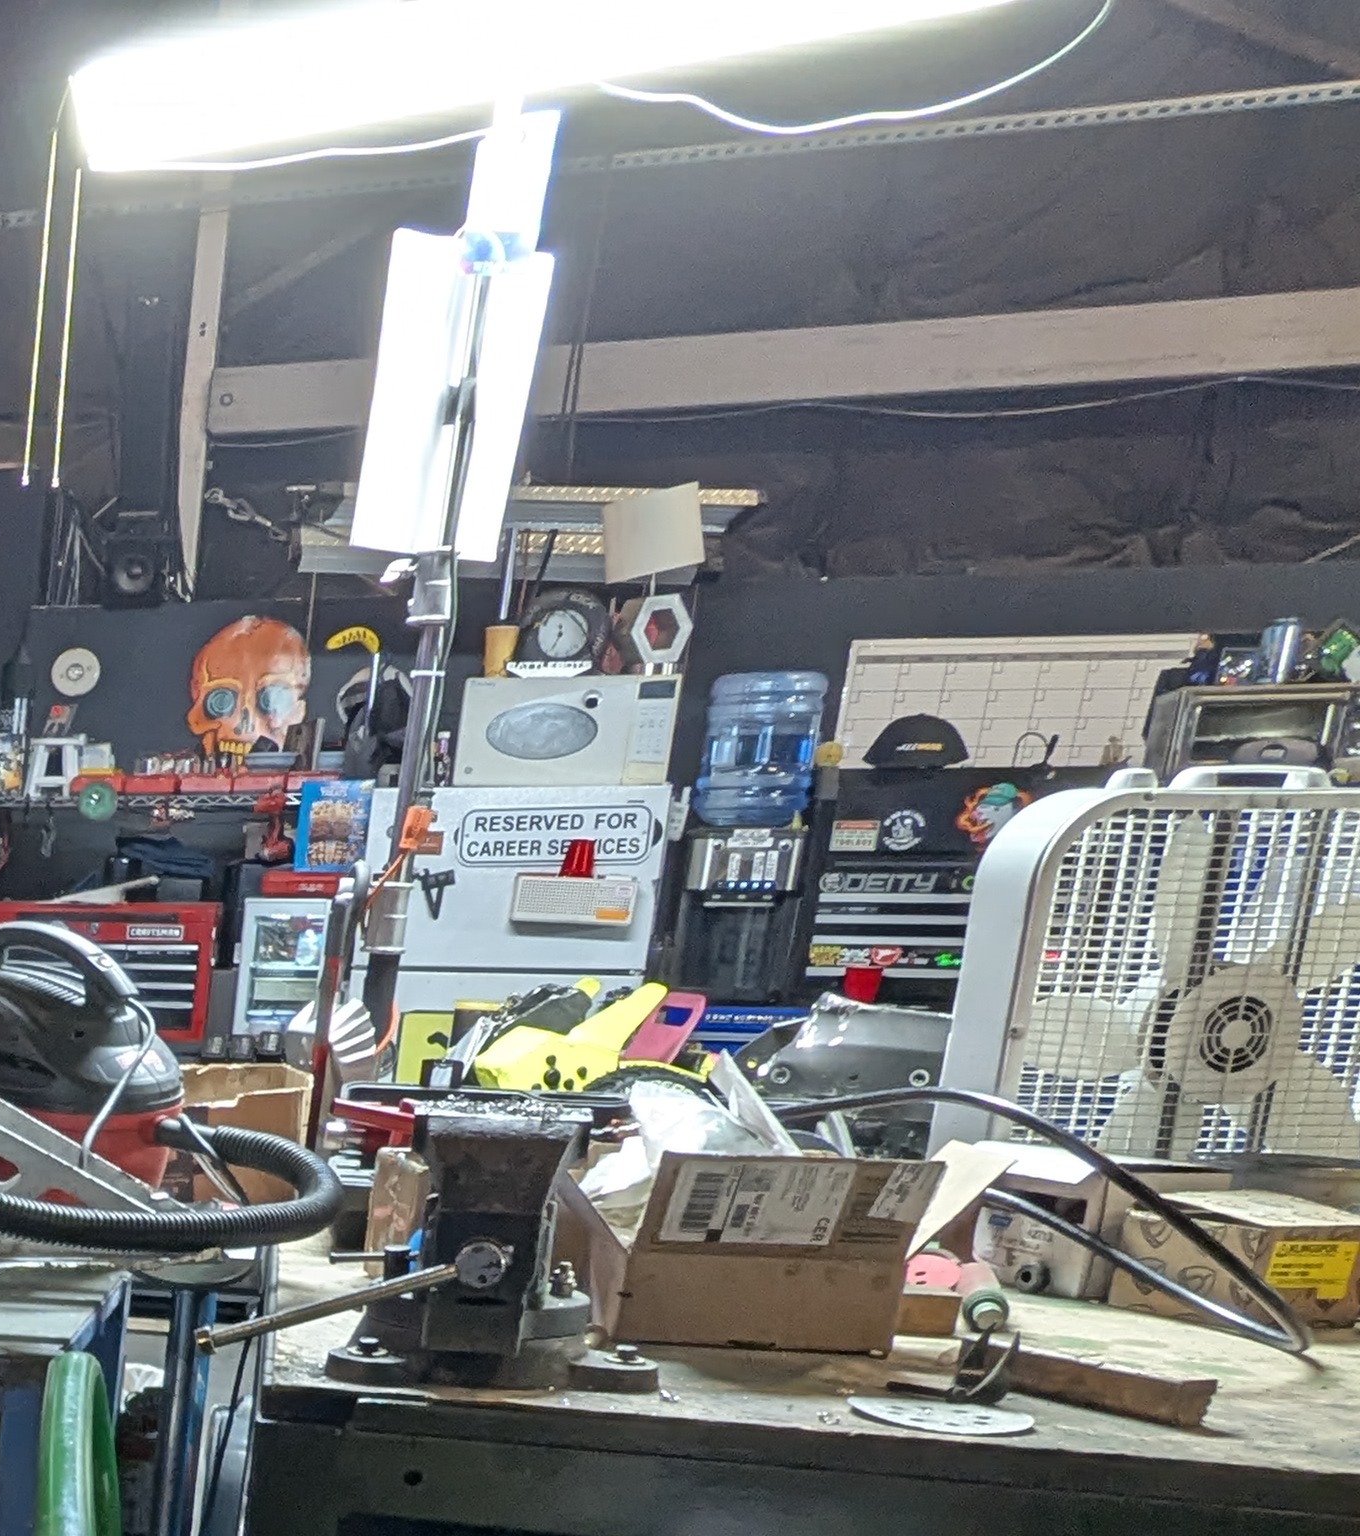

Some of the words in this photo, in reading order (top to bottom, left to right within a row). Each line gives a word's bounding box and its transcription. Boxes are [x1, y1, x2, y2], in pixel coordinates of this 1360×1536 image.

[474, 813, 585, 832] RESERVED
[594, 812, 637, 830] FOR
[467, 839, 542, 857] CAREER
[547, 837, 640, 856] SEICES
[843, 872, 939, 893] DEITY
[130, 928, 181, 937] CRAFTSMAN
